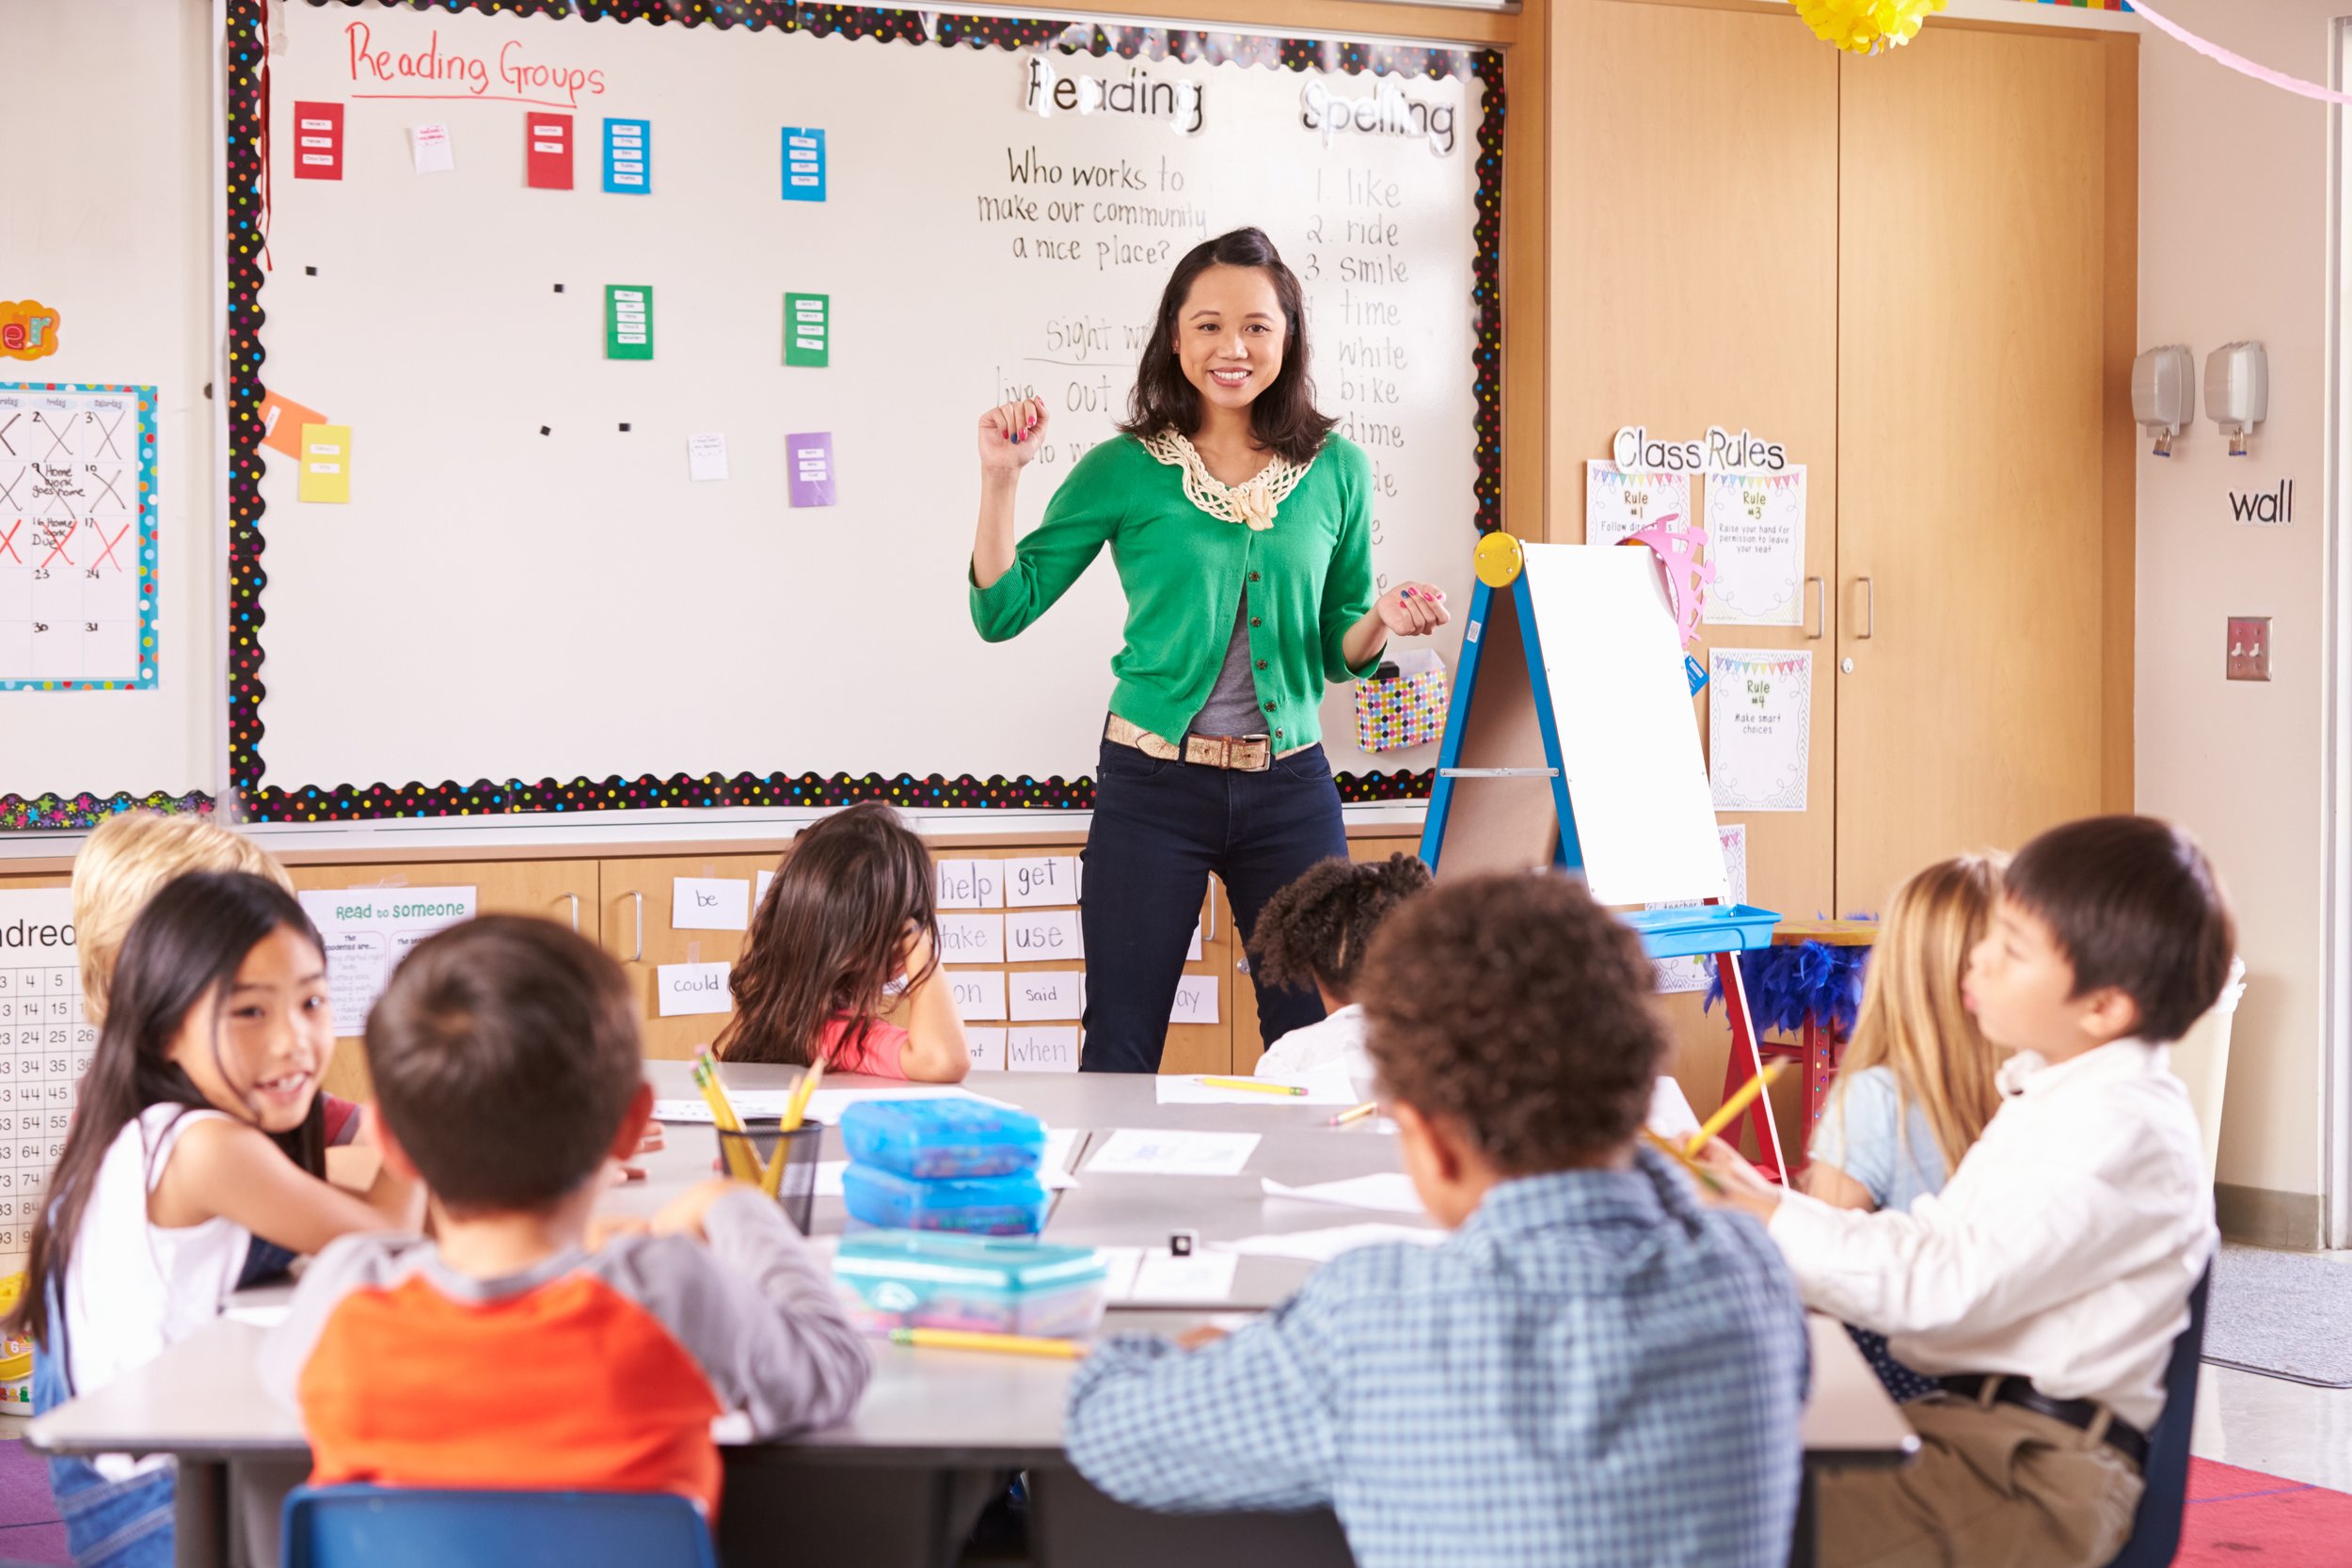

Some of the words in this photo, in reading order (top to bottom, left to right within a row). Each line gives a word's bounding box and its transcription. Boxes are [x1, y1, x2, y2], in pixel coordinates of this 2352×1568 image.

[345, 21, 488, 94] Reading
[500, 40, 605, 106] Groups
[1303, 83, 1454, 152] Spelling
[1007, 145, 1063, 184] Who
[1073, 158, 1148, 191] works
[1157, 154, 1184, 192] to
[1347, 167, 1401, 208] like
[977, 194, 1040, 222] make
[1047, 200, 1085, 224] our
[1093, 200, 1207, 241] community
[1346, 213, 1400, 247] ride
[1012, 236, 1028, 259] a
[1035, 236, 1082, 261] nice
[1096, 234, 1170, 271] place?
[1340, 288, 1402, 326] time
[1339, 335, 1408, 370] white
[1340, 367, 1400, 404] bike
[32, 411, 41, 422] 2
[85, 411, 93, 423] 3
[1340, 410, 1405, 449] dime
[1617, 428, 1702, 470] Class
[1708, 428, 1786, 470] Rules
[85, 464, 98, 472] 10
[1624, 490, 1648, 505] Rule
[1742, 490, 1767, 505] Rule
[2229, 478, 2294, 523] wall
[1601, 520, 1627, 532] Follow
[1719, 523, 1740, 532] Raise
[1741, 526, 1756, 534] your
[1758, 525, 1776, 534] hand
[1778, 525, 1790, 534] for
[1719, 534, 1756, 544] permission
[1758, 535, 1767, 544] to
[1769, 534, 1789, 544] leave
[1737, 546, 1752, 554] your
[1755, 545, 1772, 553] seat
[34, 569, 51, 580] 23
[33, 622, 49, 633] 30
[1746, 679, 1771, 694] Rule
[1734, 713, 1756, 723] Make
[1758, 713, 1781, 723] smart
[1742, 724, 1772, 735] choices
[941, 861, 993, 907] help
[1018, 858, 1057, 896] get
[695, 889, 719, 908] be
[336, 903, 373, 921] Read
[376, 909, 389, 918] to
[392, 903, 465, 919] someone
[941, 924, 988, 950] take
[1015, 927, 1064, 948] use
[26, 974, 36, 988] 4
[55, 974, 63, 987] 5
[674, 974, 719, 992] could
[24, 1002, 39, 1016] 14
[51, 1002, 68, 1015] 15
[21, 1030, 40, 1044] 24
[49, 1030, 67, 1043] 25
[77, 1029, 95, 1042] 26
[21, 1060, 40, 1073] 34
[49, 1059, 67, 1072] 35
[21, 1088, 40, 1101] 44
[48, 1087, 68, 1100] 45
[22, 1117, 40, 1130] 54
[50, 1116, 68, 1129] 55
[22, 1145, 40, 1158] 64
[23, 1173, 40, 1187] 74
